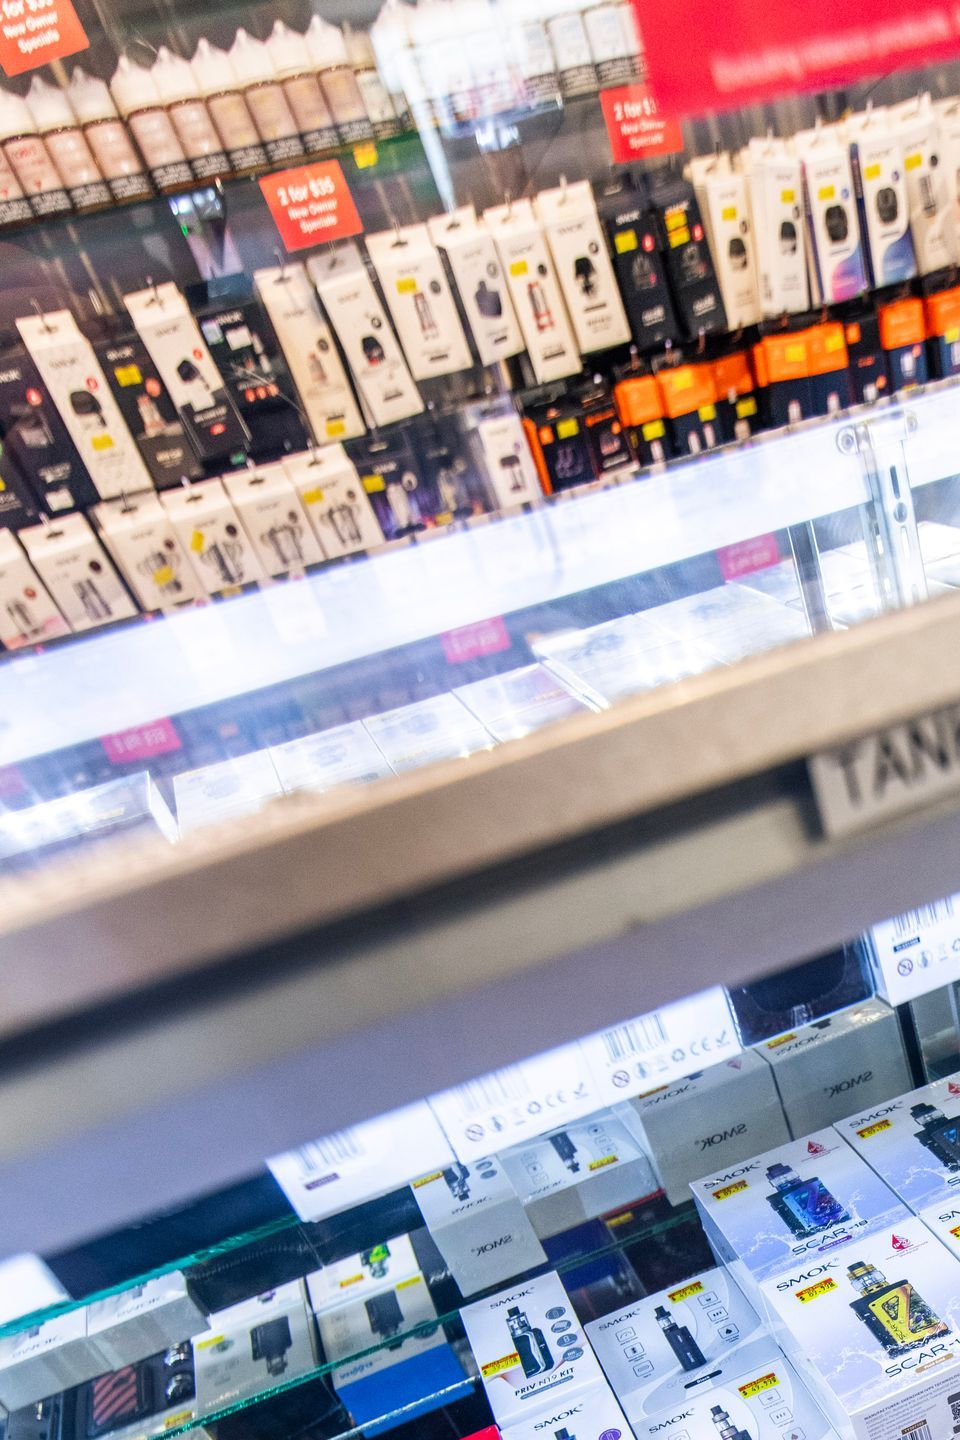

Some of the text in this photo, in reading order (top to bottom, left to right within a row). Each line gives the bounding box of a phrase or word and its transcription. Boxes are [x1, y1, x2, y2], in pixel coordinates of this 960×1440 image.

[848, 1103, 903, 1130] SMOK
[703, 1163, 758, 1190] SMOK
[791, 1219, 869, 1257] SCAR-18
[776, 1261, 839, 1293] SMOK
[489, 1288, 532, 1310] SMOK
[598, 1309, 640, 1332] SMOK
[514, 1382, 537, 1397] PRIV
[559, 1366, 576, 1380] KIT
[533, 1405, 581, 1432] SMOK
[648, 1410, 695, 1434] SMOK
